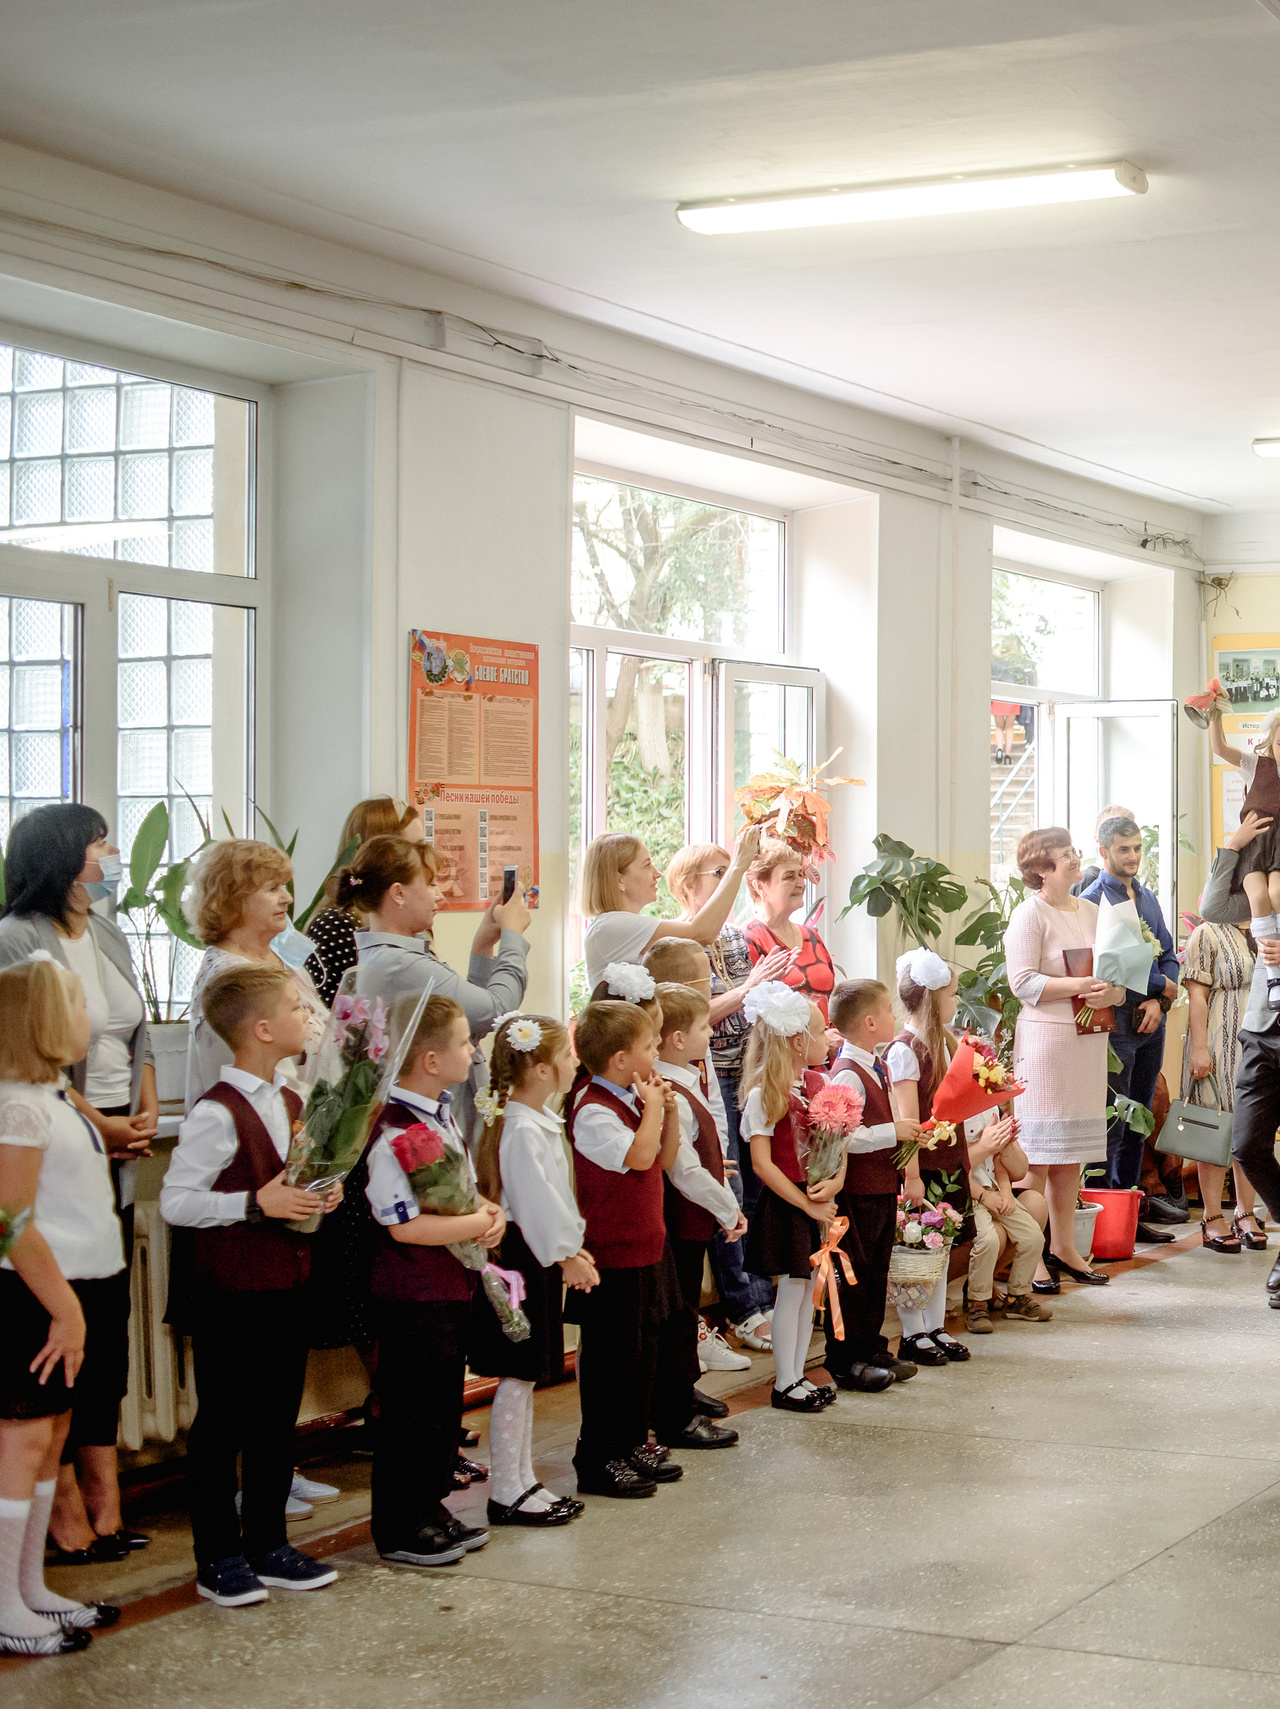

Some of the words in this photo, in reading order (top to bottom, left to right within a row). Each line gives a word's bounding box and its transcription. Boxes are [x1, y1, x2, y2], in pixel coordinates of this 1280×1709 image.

[475, 665, 498, 682] БОЕВОЕ
[500, 667, 529, 686] БРАТСТВО
[1242, 723, 1260, 731] Истор
[440, 789, 464, 803] Песни
[464, 790, 490, 804] нашей
[490, 790, 520, 805] победы
